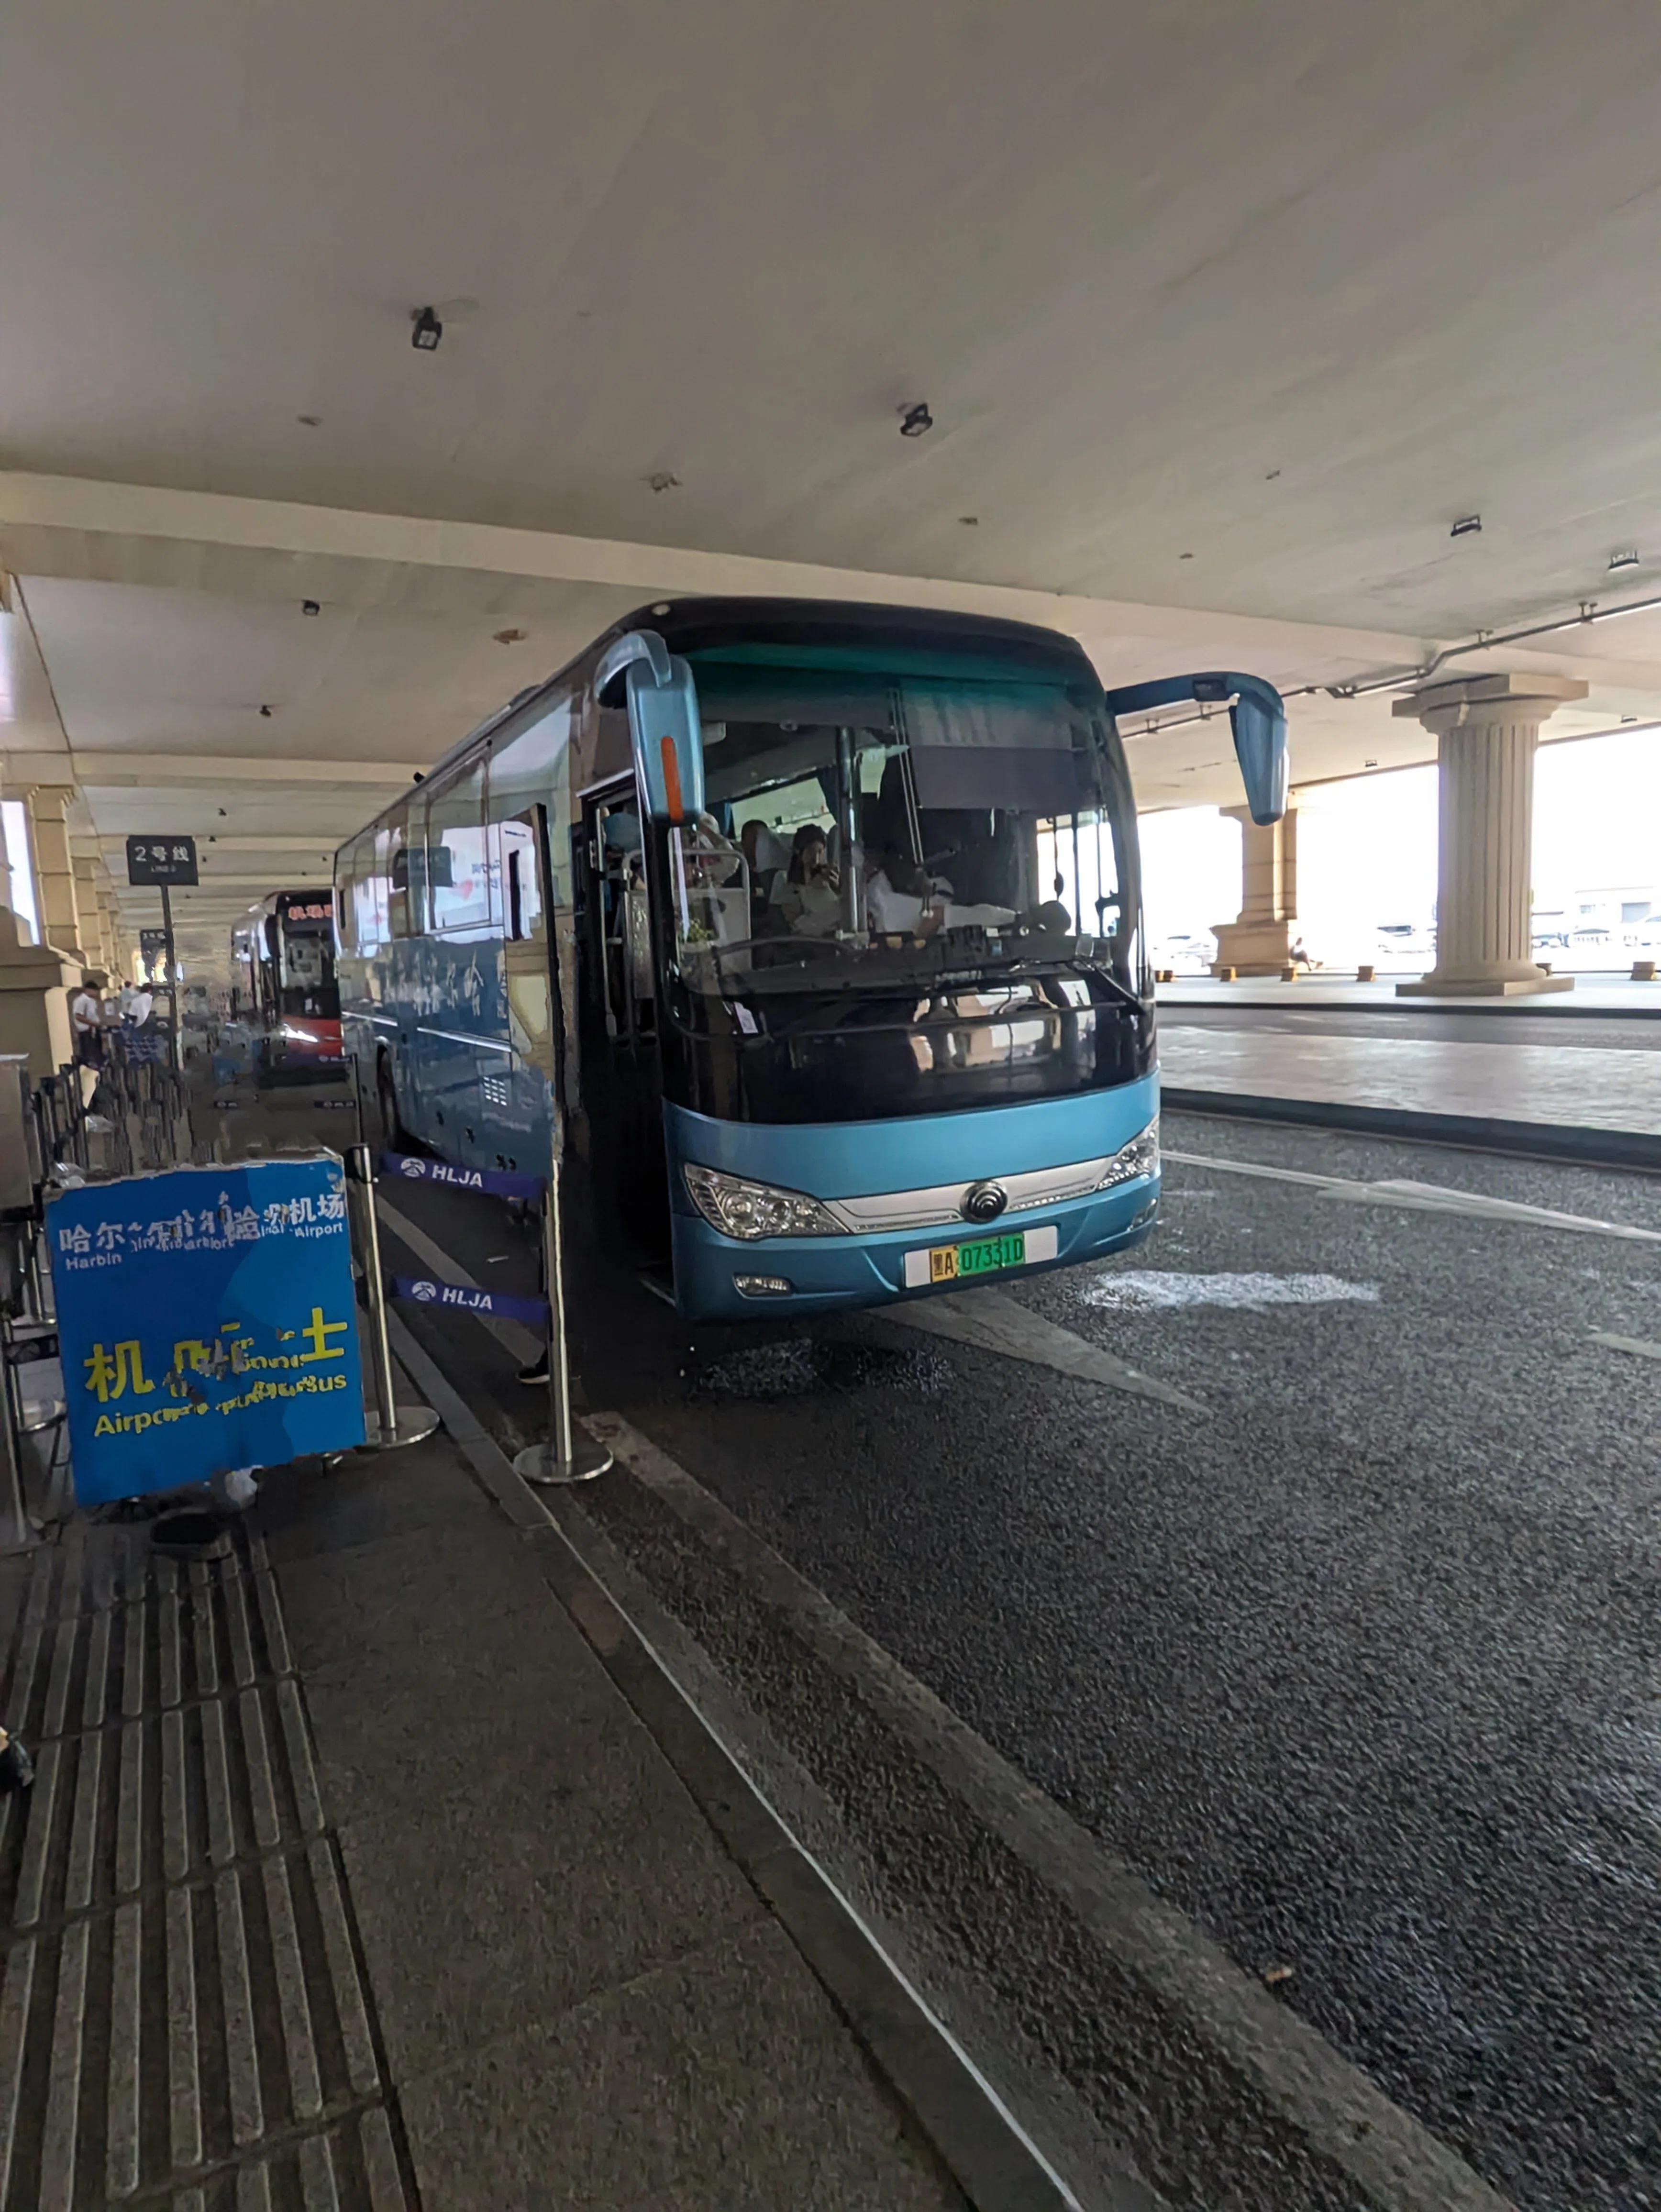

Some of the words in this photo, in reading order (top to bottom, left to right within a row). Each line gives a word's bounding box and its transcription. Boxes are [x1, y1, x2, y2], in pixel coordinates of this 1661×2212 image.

[432, 1164, 483, 1188] HLJA
[66, 1252, 122, 1270] Harbin
[443, 1287, 492, 1310] HLJA
